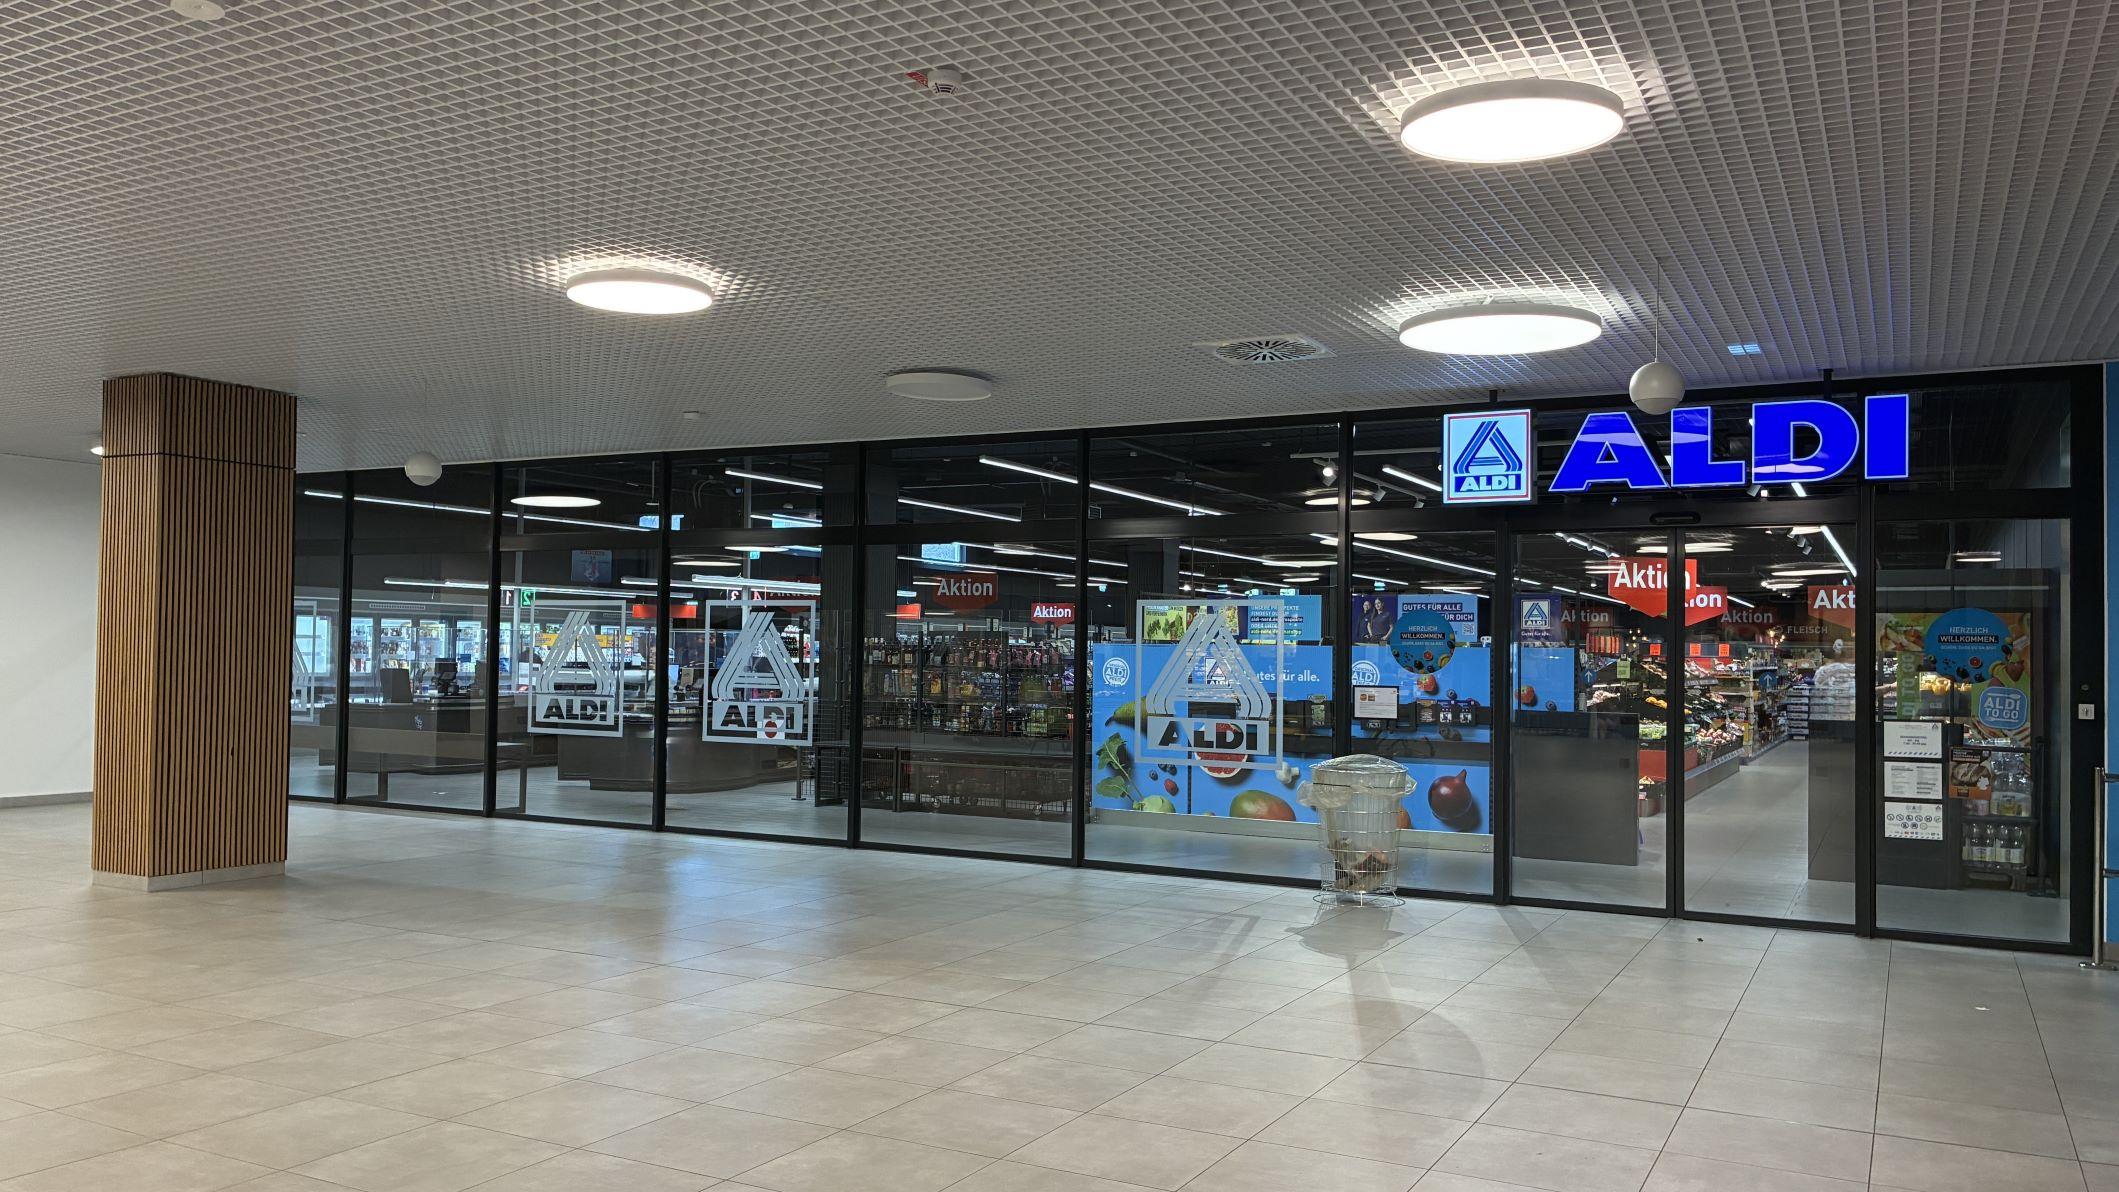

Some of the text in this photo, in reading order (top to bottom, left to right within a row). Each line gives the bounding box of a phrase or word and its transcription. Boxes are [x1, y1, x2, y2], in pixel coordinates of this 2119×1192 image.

[1549, 395, 1909, 491] ALDI
[1460, 476, 1516, 492] ALDI
[937, 578, 993, 596] Aktion
[1033, 604, 1072, 618] Aktion
[1427, 603, 1442, 611] FÜR
[1721, 609, 1773, 624] Aktion
[1787, 626, 1828, 634] FLEISCH
[1949, 626, 1989, 634] HERZLICH
[1105, 667, 1127, 679] ALDI
[1298, 671, 1320, 681] alle.
[1352, 671, 1377, 682] ALDI
[543, 699, 608, 721] ALDI
[1984, 698, 2020, 710] ALDI
[720, 705, 795, 730] ALDI
[1985, 708, 2019, 719] TO GO
[1158, 721, 1258, 750] ALDI
